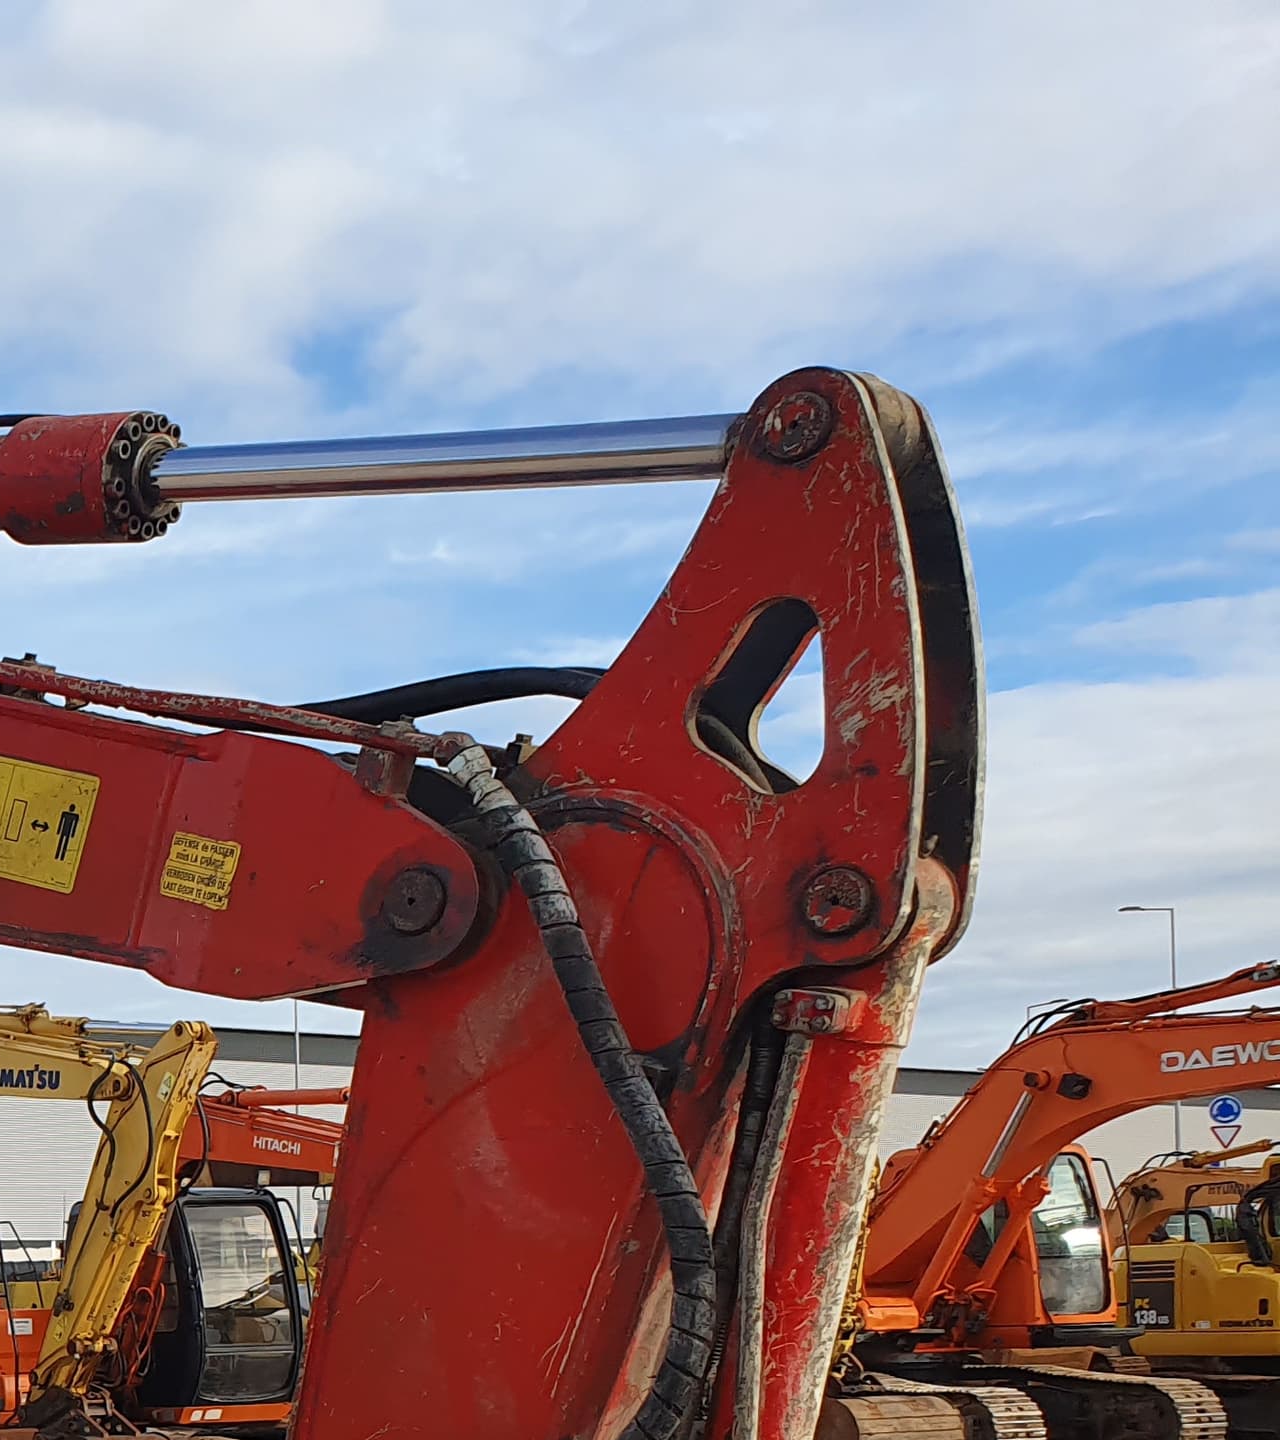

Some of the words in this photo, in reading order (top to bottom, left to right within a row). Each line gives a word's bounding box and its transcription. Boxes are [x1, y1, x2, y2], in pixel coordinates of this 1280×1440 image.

[190, 853, 198, 862] LA
[217, 880, 227, 890] DE
[253, 1135, 301, 1155] HITACHI
[1134, 1298, 1150, 1309] PC
